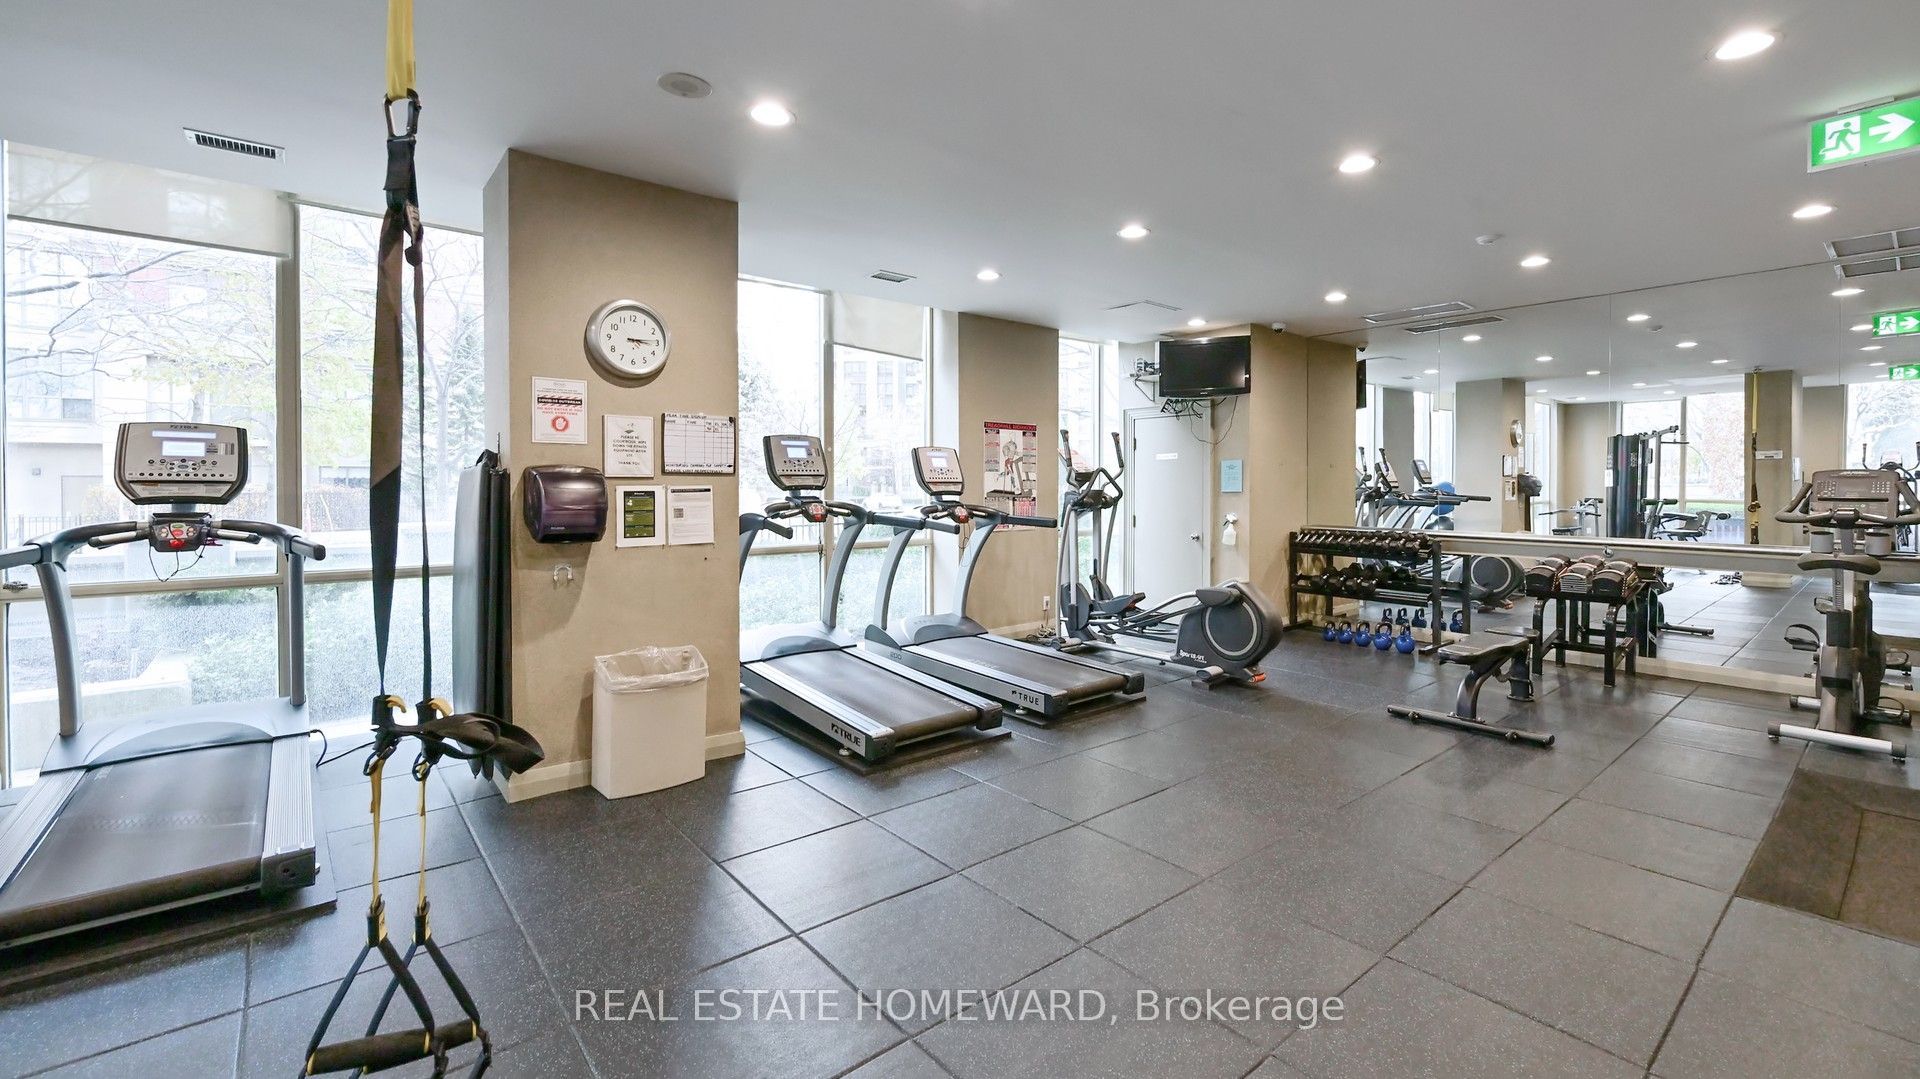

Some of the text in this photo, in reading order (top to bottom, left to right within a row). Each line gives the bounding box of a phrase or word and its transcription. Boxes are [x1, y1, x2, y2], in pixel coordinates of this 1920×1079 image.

[619, 316, 626, 324] 11
[629, 314, 637, 323] 12
[610, 323, 619, 331] 10
[650, 327, 656, 335] 2
[606, 333, 612, 341] 9
[655, 339, 660, 347] 3
[610, 345, 616, 353] 8
[630, 358, 636, 366] 6
[1018, 692, 1039, 706] TRUE
[840, 727, 861, 747] TRUE
